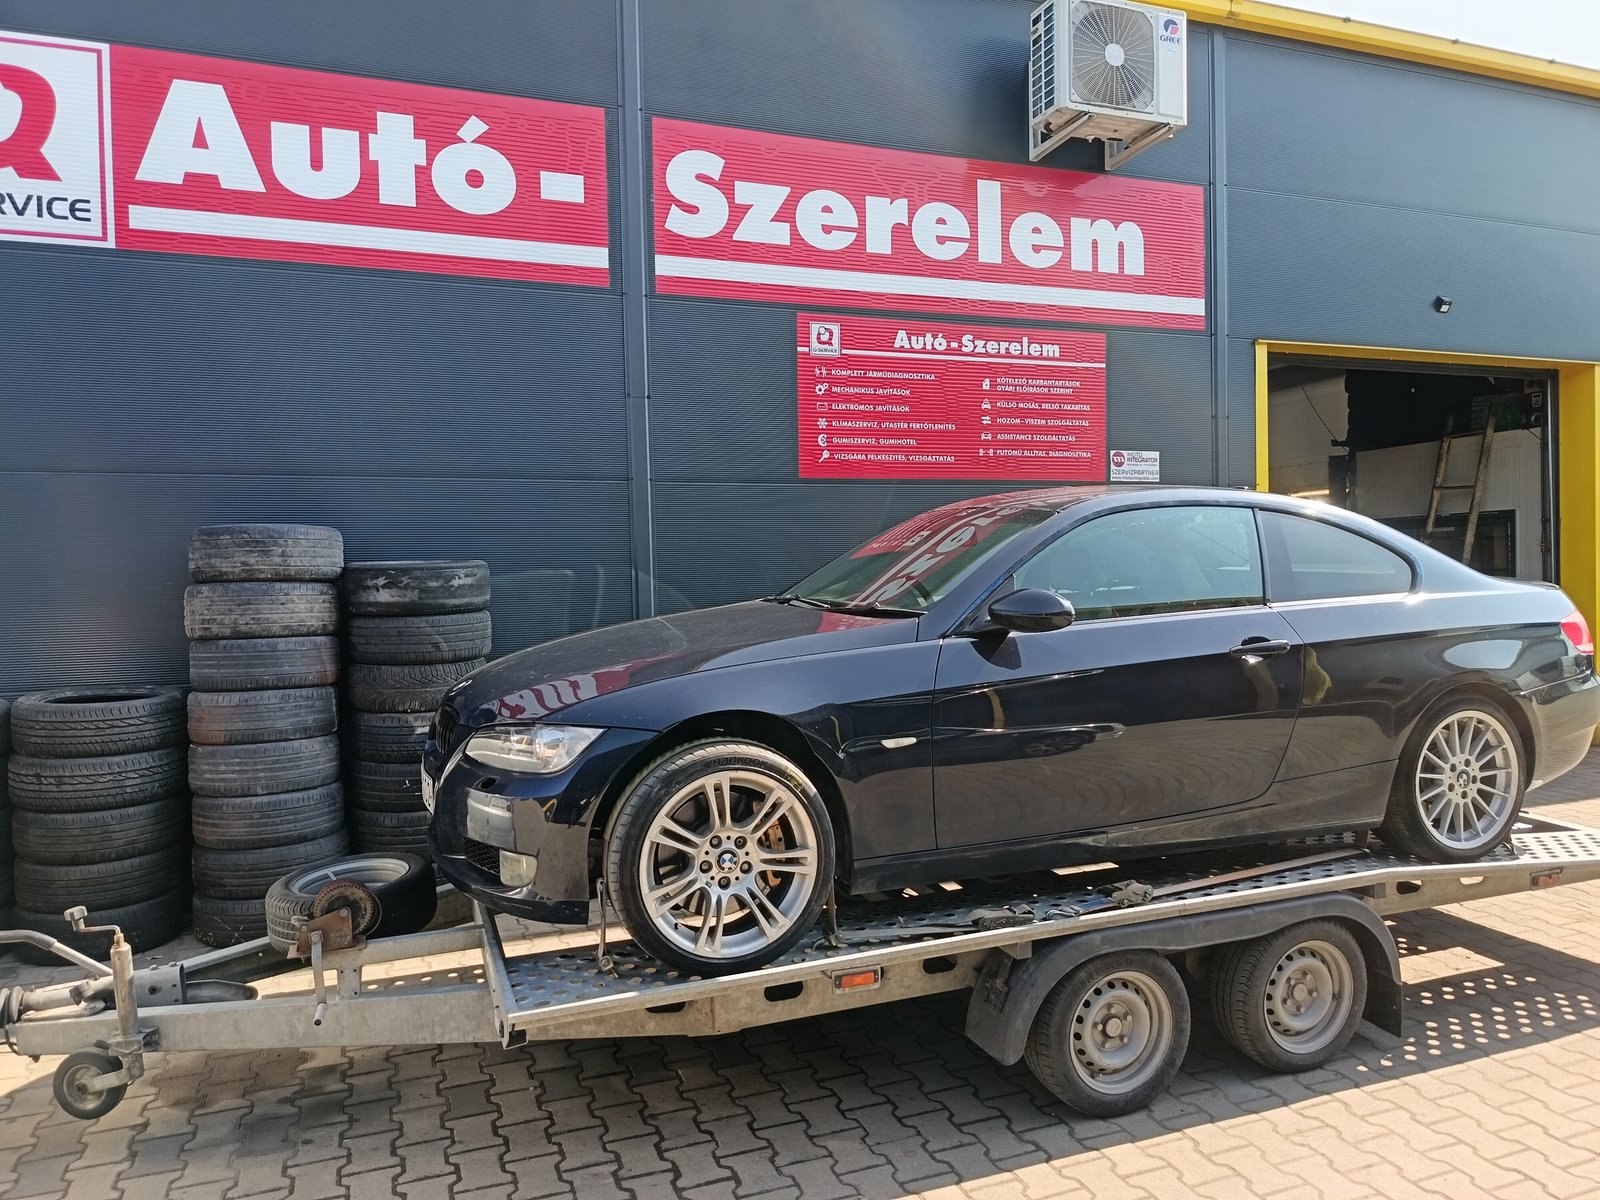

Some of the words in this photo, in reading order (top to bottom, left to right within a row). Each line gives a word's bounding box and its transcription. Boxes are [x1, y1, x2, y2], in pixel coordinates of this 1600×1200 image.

[1160, 35, 1182, 45] GREE
[0, 192, 92, 223] VICE
[665, 149, 1145, 276] Szerelem
[831, 369, 864, 377] KOMPLETT
[1028, 378, 1081, 387] KARBANTARTÁSOK
[831, 386, 874, 394] MECHANIKUS
[875, 387, 911, 396] JAVÍTÁSOK
[1049, 387, 1073, 395] SZERINT
[831, 403, 874, 411] ELEKTROMOS
[875, 403, 910, 412] JAVÍTÁSOK
[996, 400, 1017, 408] KÜLSŐ
[1018, 402, 1040, 410] MOSÁS,
[1041, 402, 1059, 410] BELSŐ
[832, 420, 879, 428] KLÍMASZERVIZ,
[881, 421, 908, 429] UTASTÉR
[909, 422, 956, 431] FERTŐTLENÍTÉS
[832, 437, 878, 446] GUMISZERVIZ,
[879, 438, 917, 446] GUMIHOTEL
[834, 453, 865, 461] VIZSGÁRA
